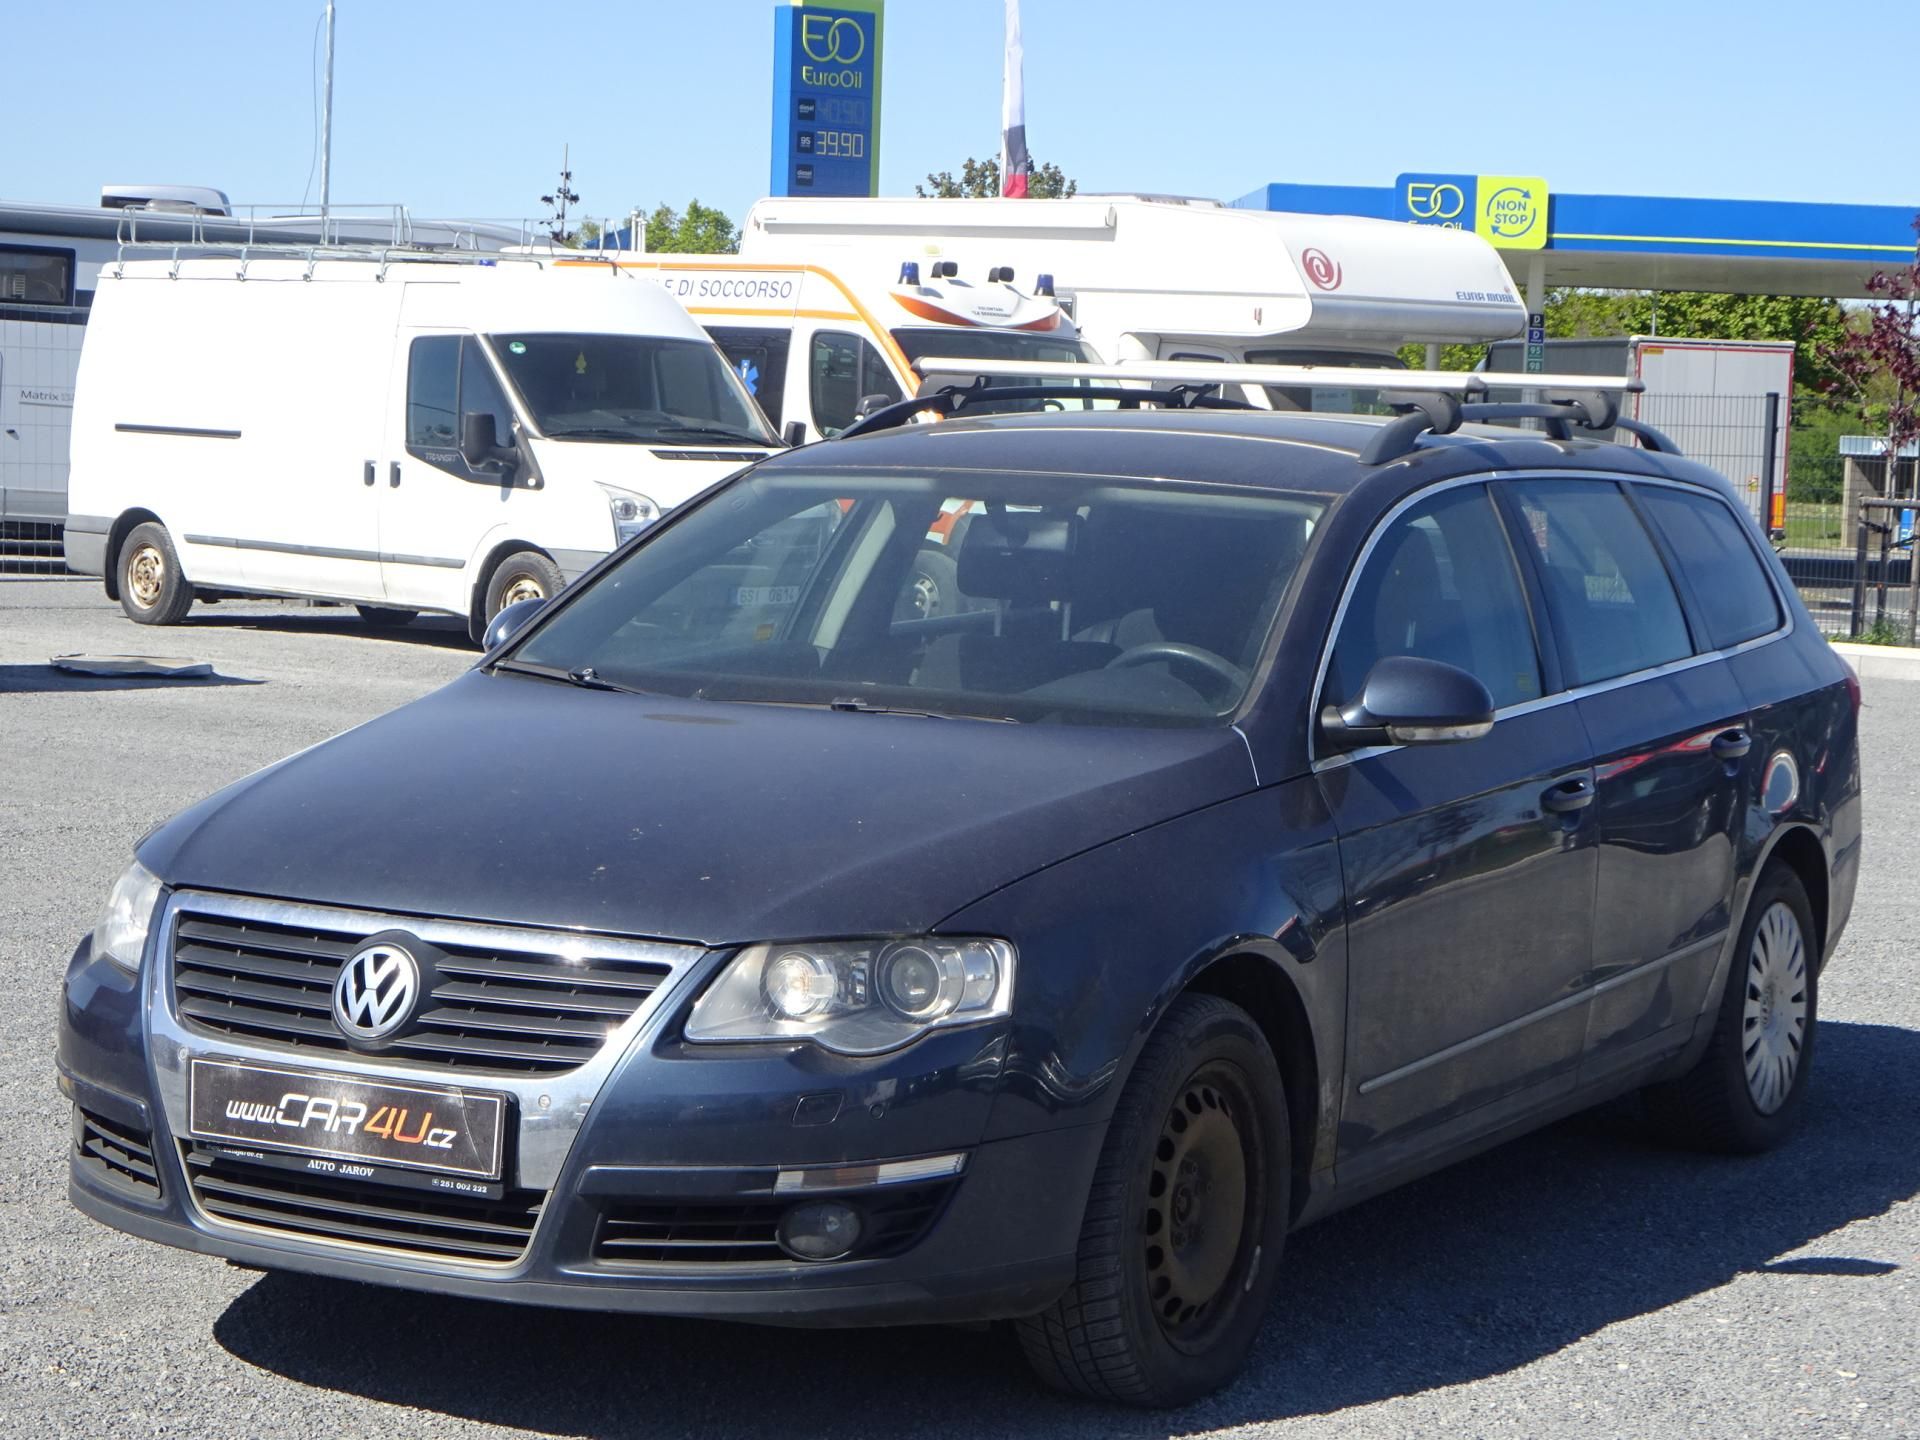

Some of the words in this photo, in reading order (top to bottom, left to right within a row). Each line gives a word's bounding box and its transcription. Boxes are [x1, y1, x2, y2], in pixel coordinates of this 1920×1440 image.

[803, 65, 862, 88] EuroOil
[816, 130, 864, 157] 39.90
[1496, 199, 1527, 211] NON
[1494, 213, 1528, 224] STOP
[678, 280, 694, 296] DI
[699, 279, 793, 298] SOCCORSO
[1534, 315, 1541, 323] D
[1533, 330, 1540, 339] D
[1530, 346, 1541, 355] 95
[21, 390, 59, 401] Matrix
[226, 1093, 457, 1149] www.CAR4U.cz
[307, 1159, 335, 1172] AUTO
[339, 1164, 374, 1177] JAROV
